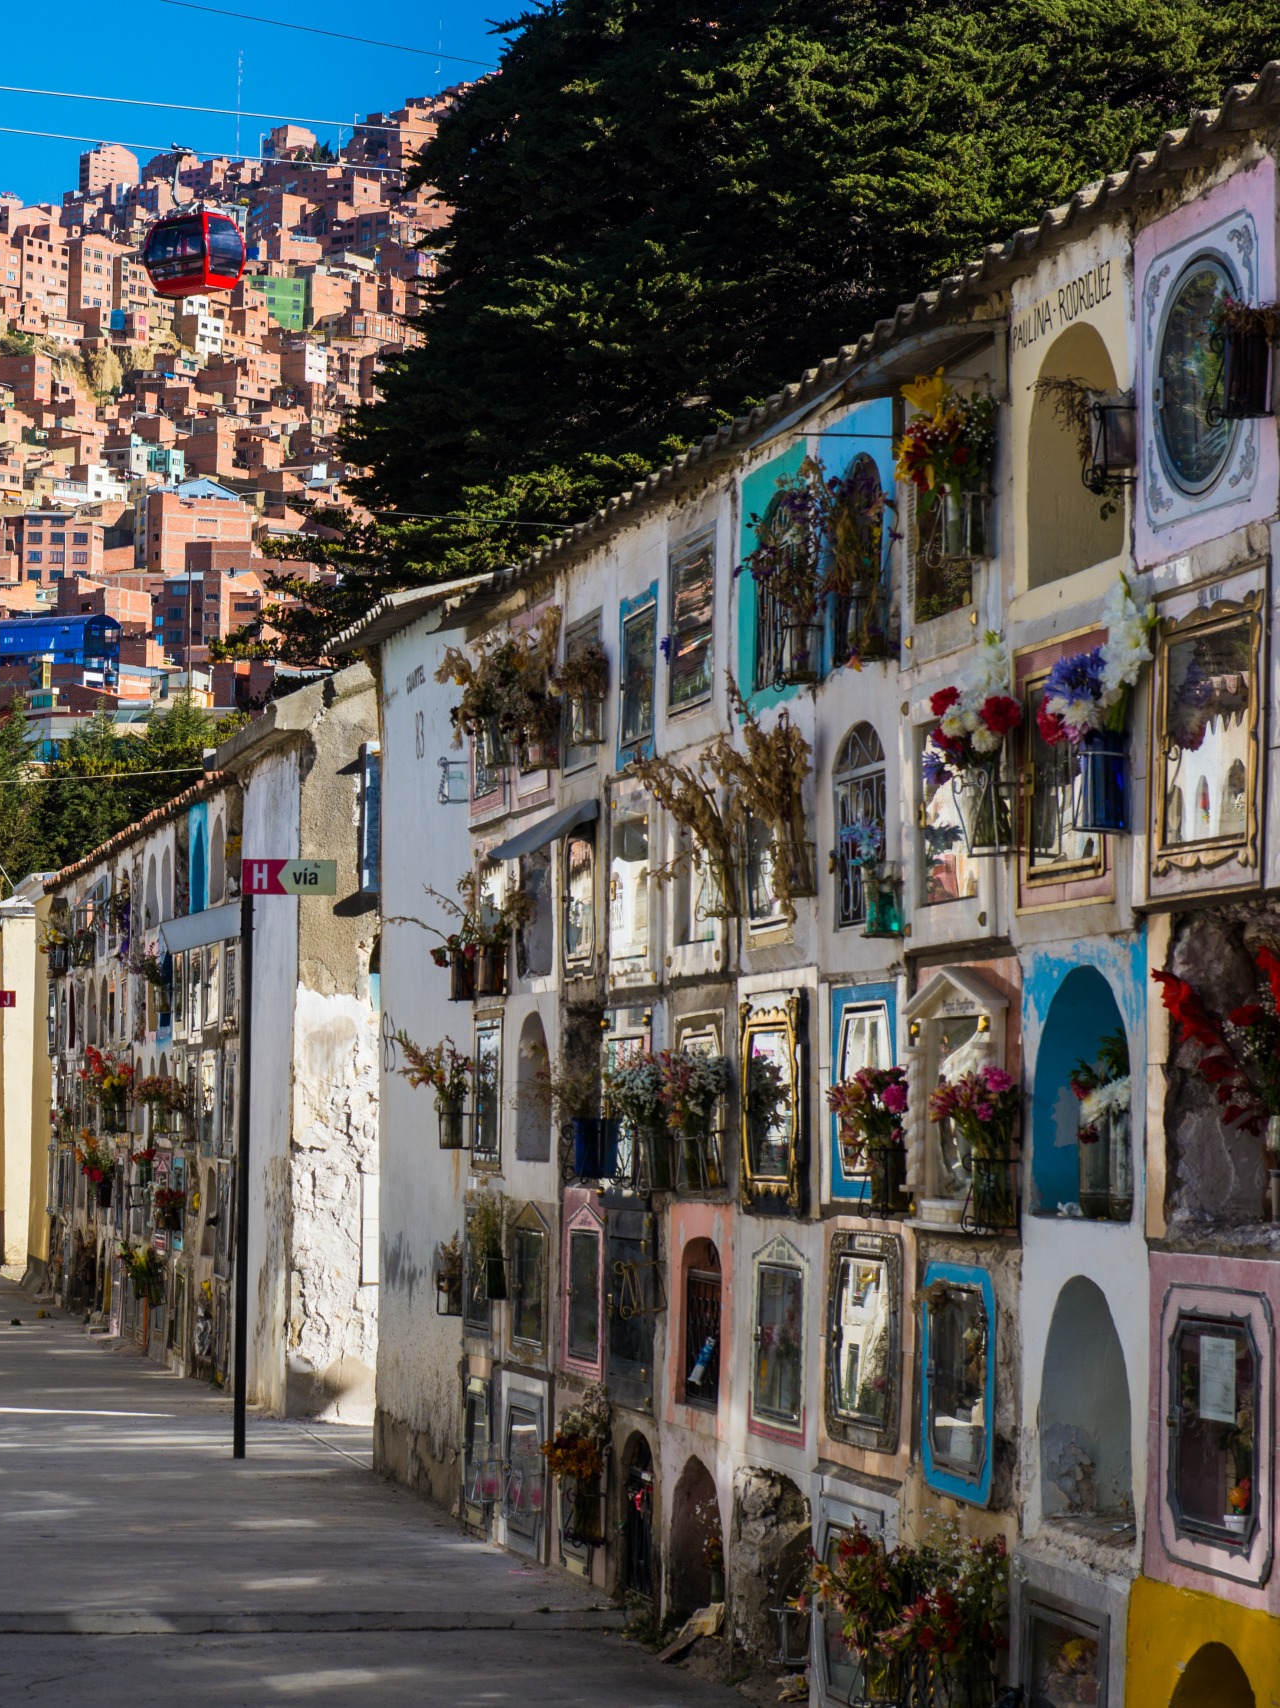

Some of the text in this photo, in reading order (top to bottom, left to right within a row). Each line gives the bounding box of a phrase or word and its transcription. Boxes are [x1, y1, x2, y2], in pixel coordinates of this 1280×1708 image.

[1012, 260, 1112, 353] PAULINA RODRIGUEZ
[415, 710, 424, 759] 83
[252, 863, 318, 889] H vía
[3, 992, 10, 1006] J
